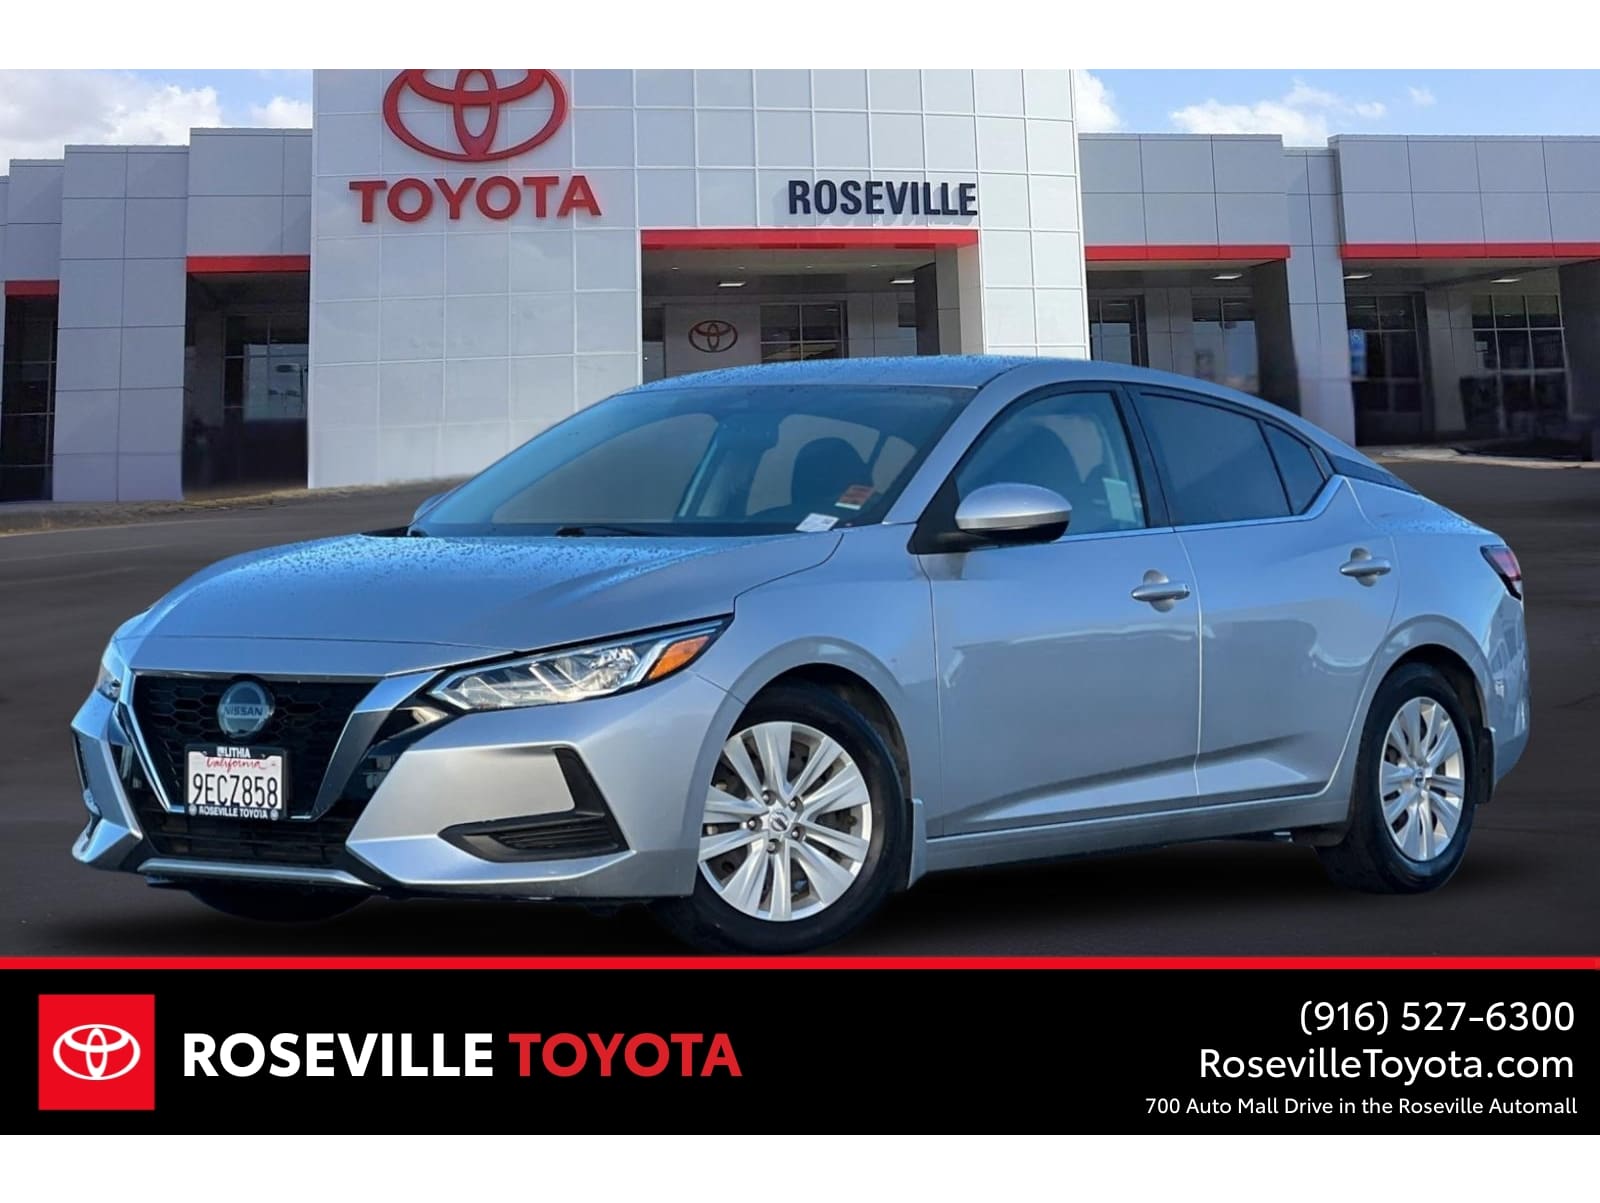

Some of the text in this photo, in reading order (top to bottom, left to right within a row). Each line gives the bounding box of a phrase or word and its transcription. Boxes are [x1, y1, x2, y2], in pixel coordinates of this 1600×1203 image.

[349, 175, 602, 223] TOYOTA
[788, 179, 978, 216] ROSEVILLE
[223, 705, 264, 717] NISSAN
[225, 746, 251, 759] LITHIA
[206, 757, 266, 773] California
[192, 773, 278, 807] 9ECZ858
[198, 806, 269, 820] ROSEVILLE TOYOTA
